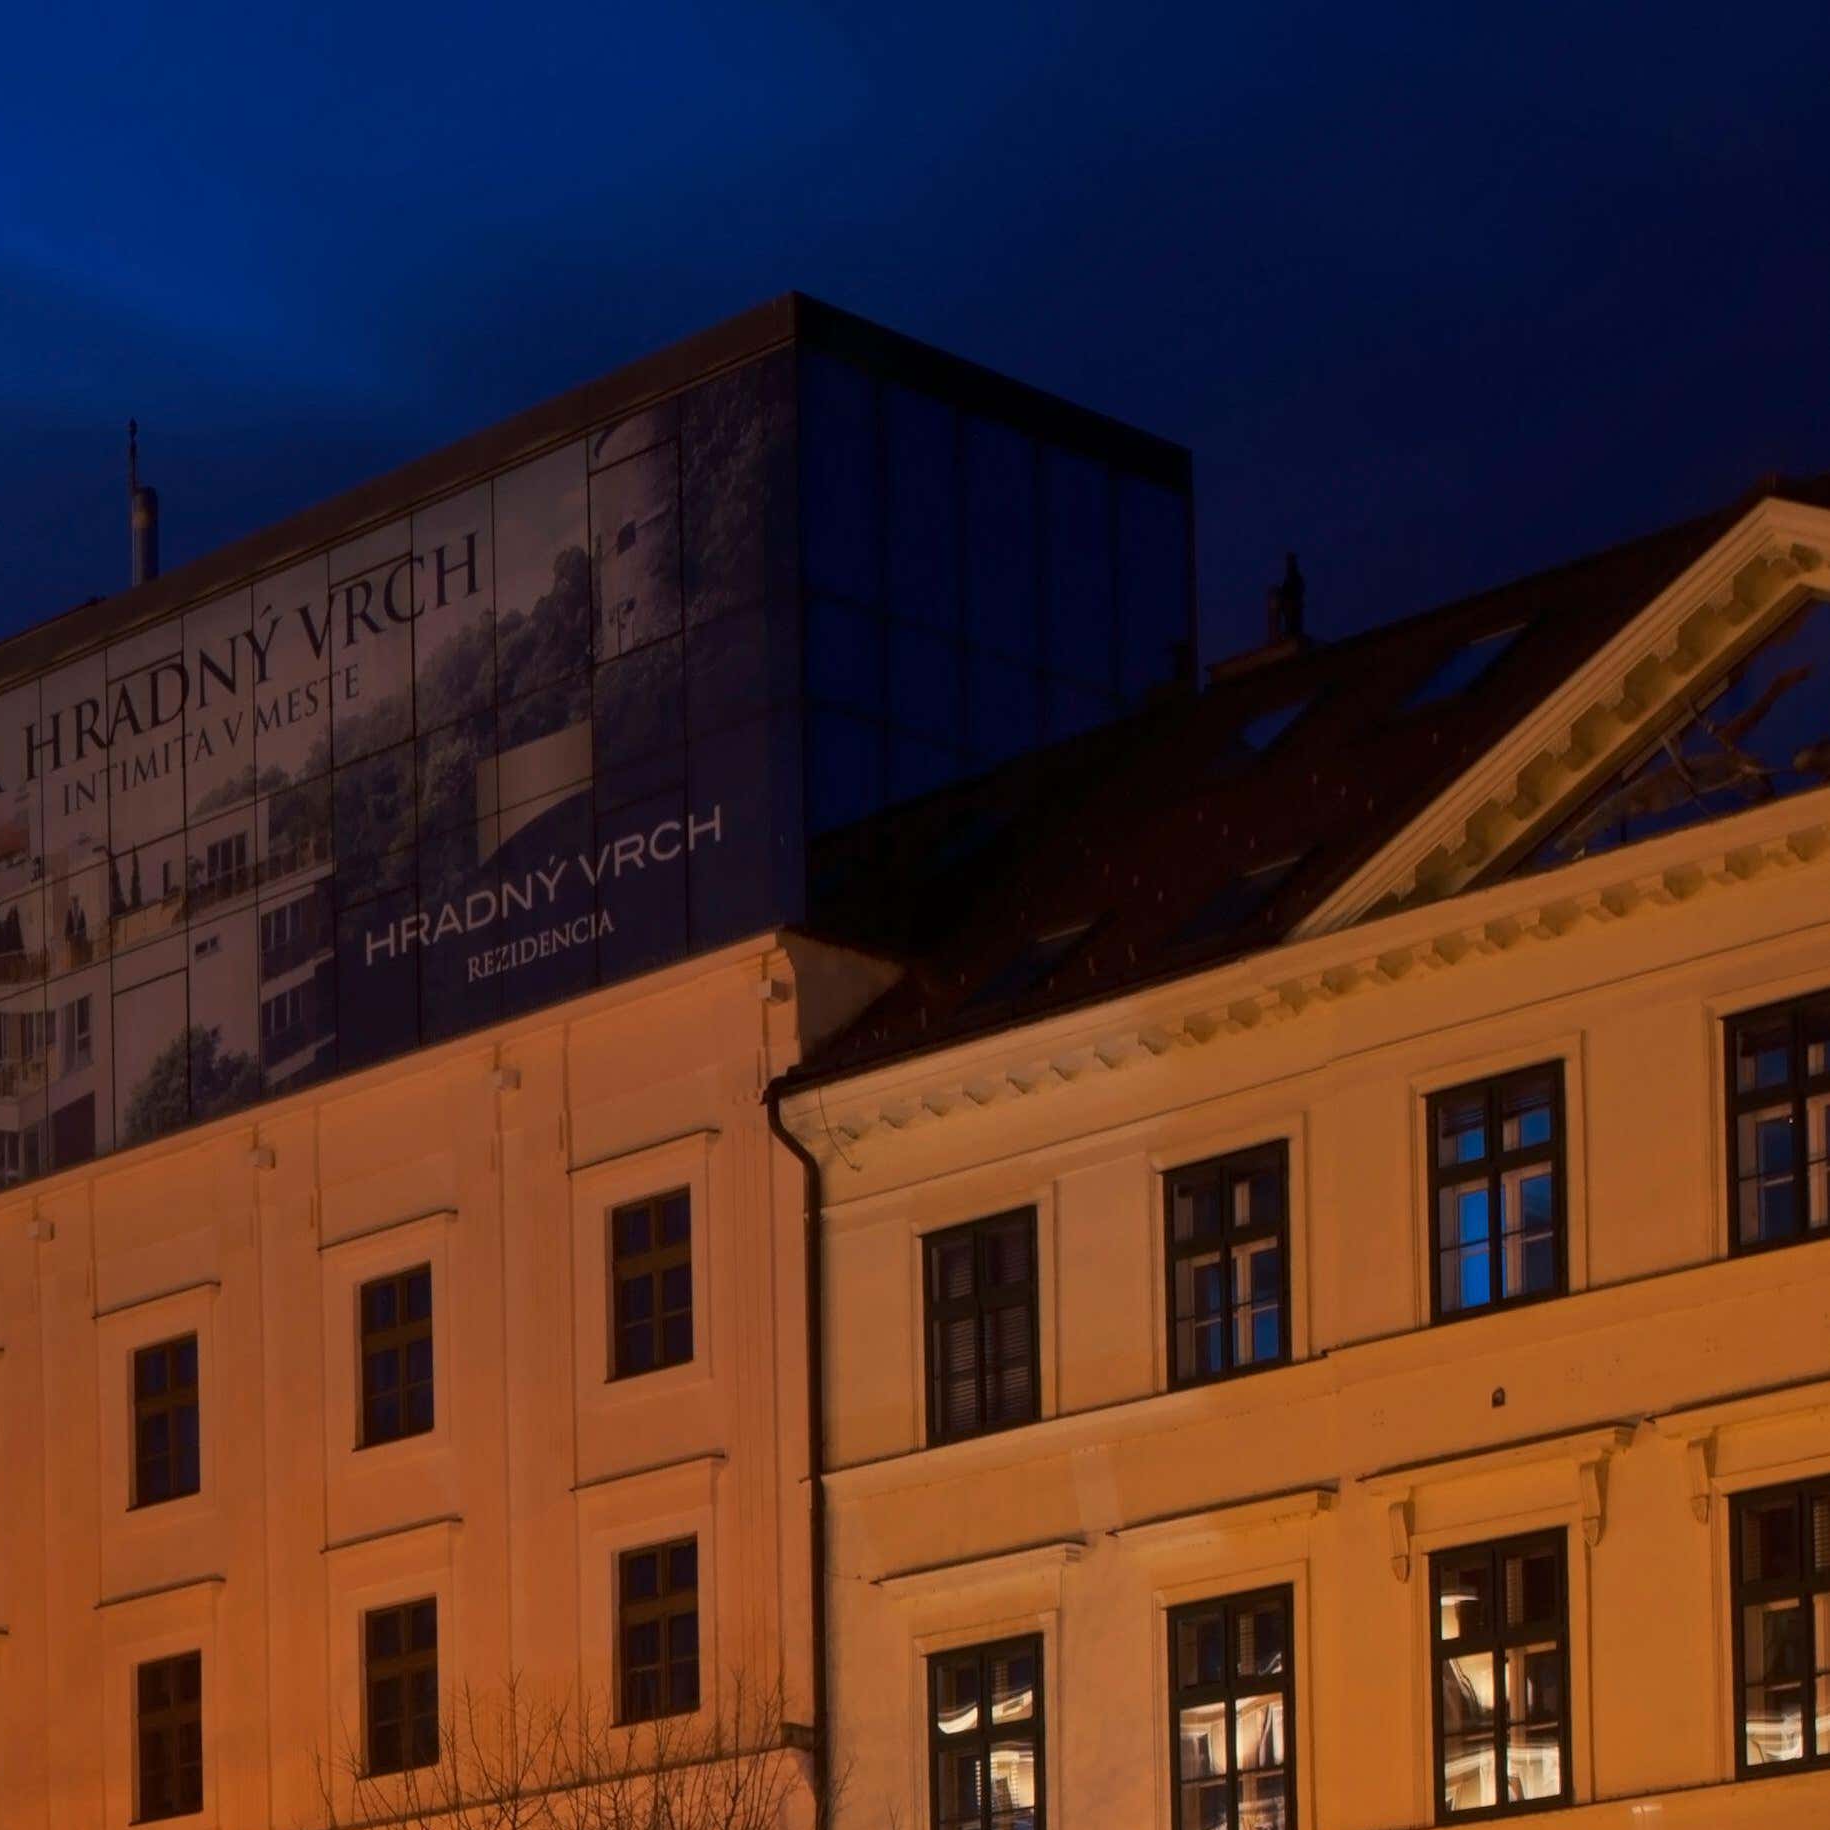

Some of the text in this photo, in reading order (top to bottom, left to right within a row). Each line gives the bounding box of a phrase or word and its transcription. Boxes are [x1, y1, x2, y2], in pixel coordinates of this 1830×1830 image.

[24, 605, 280, 781] HRADNÝ
[296, 531, 483, 661] VRCH
[63, 667, 361, 816] INTIMITA V MESTE
[366, 804, 723, 966] HRADNÝ VRCH
[467, 909, 615, 983] REZIDENCIA
